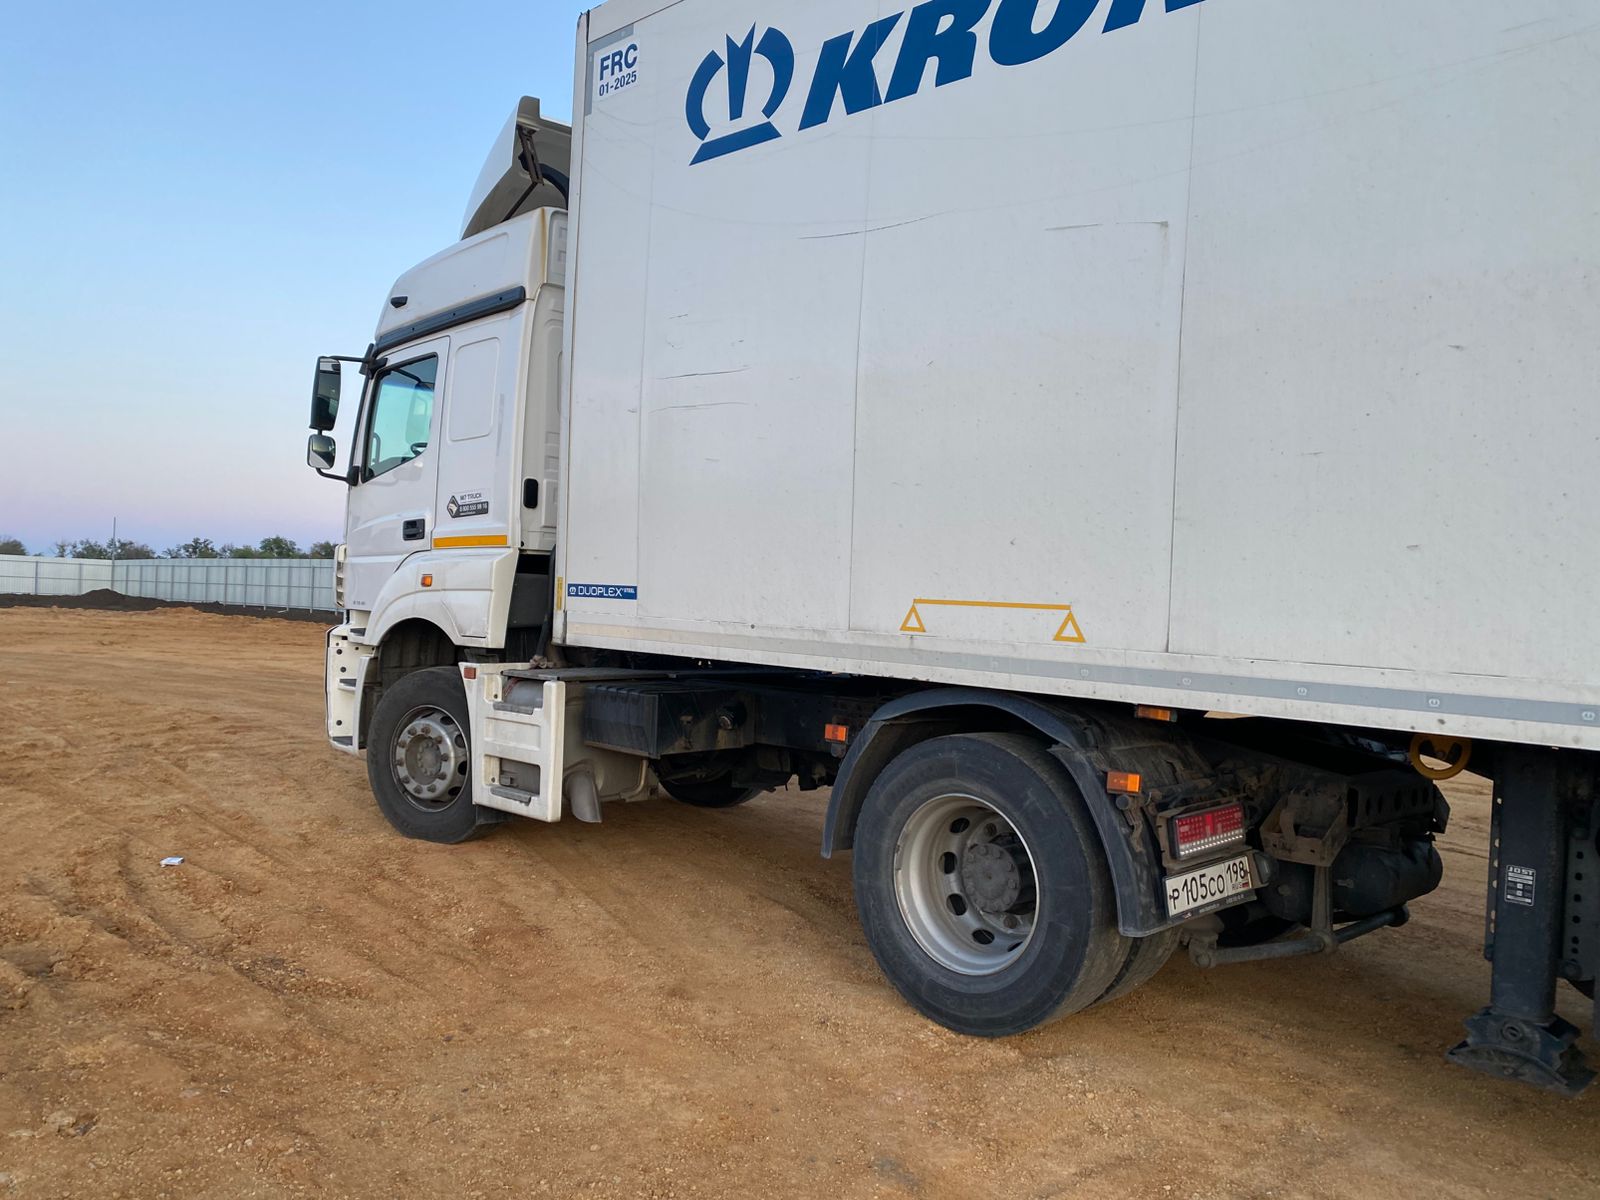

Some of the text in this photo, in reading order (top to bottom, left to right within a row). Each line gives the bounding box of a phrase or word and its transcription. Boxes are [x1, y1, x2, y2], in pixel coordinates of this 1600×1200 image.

[600, 44, 638, 81] FRC
[599, 70, 637, 96] 01-2025
[578, 586, 622, 597] DUOPLEX
[1226, 861, 1247, 883] 198
[1508, 866, 1533, 876] JOST
